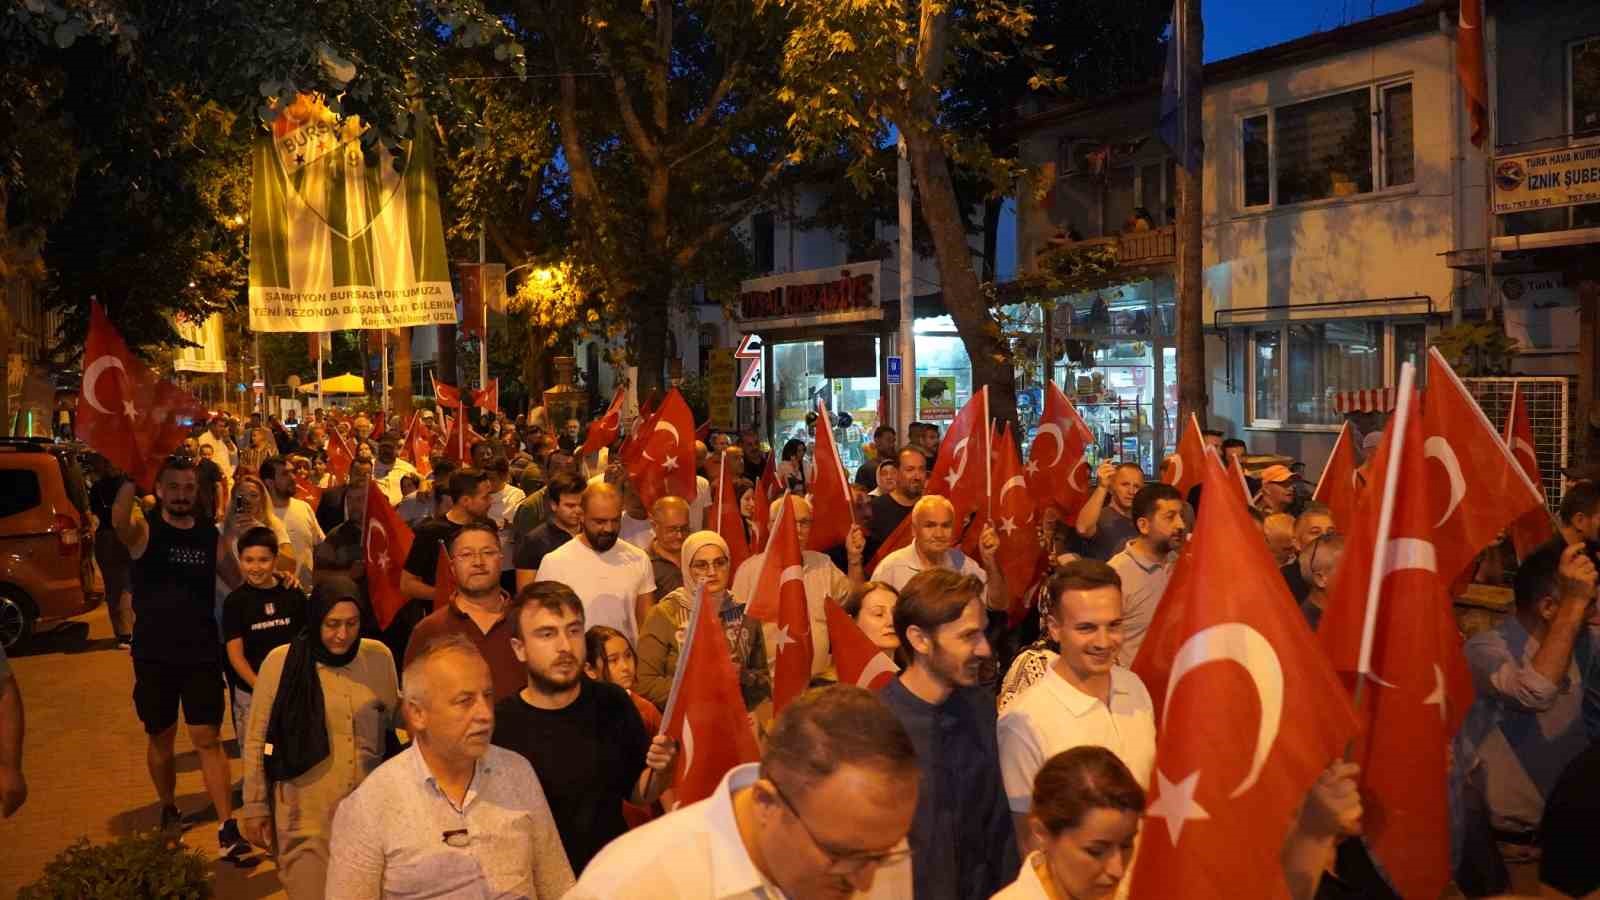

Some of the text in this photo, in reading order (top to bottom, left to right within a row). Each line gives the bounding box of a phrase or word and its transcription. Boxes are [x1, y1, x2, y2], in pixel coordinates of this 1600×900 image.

[1526, 157, 1547, 168] TÜRK
[1549, 152, 1571, 164] HAVA
[1528, 170, 1561, 190] İZNİK
[285, 306, 339, 318] SEZONDA
